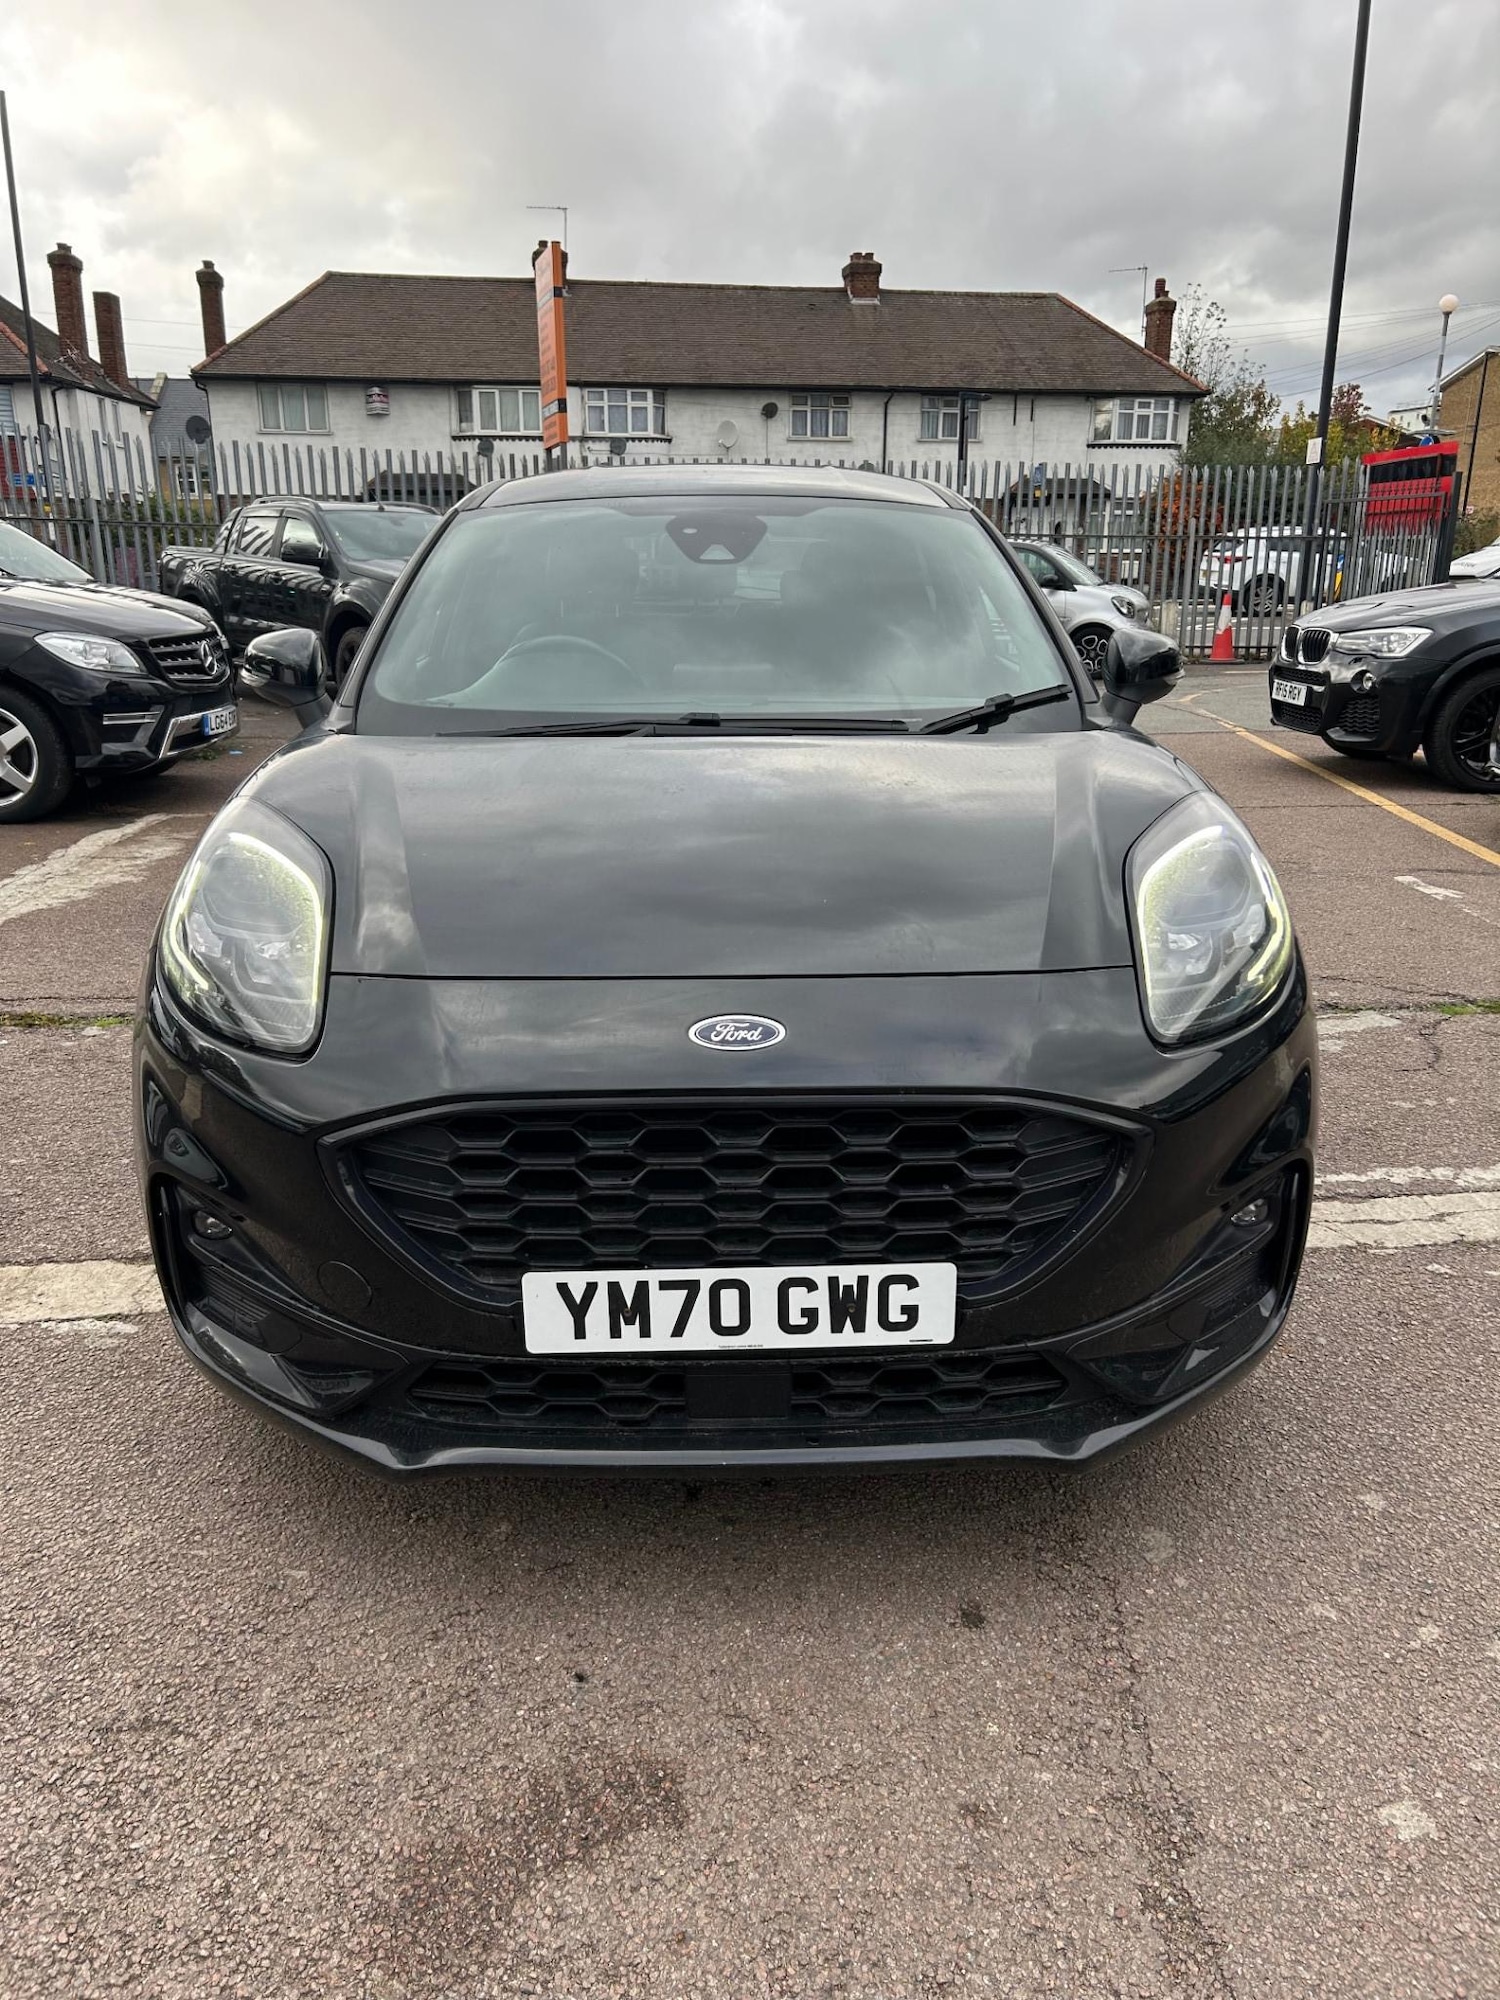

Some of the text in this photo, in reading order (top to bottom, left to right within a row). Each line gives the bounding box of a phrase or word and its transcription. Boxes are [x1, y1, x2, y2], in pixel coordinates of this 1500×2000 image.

[1288, 685, 1302, 701] RGY
[210, 713, 228, 731] LG64
[711, 1022, 763, 1041] Ford
[556, 1274, 919, 1339] YM70 GWG
